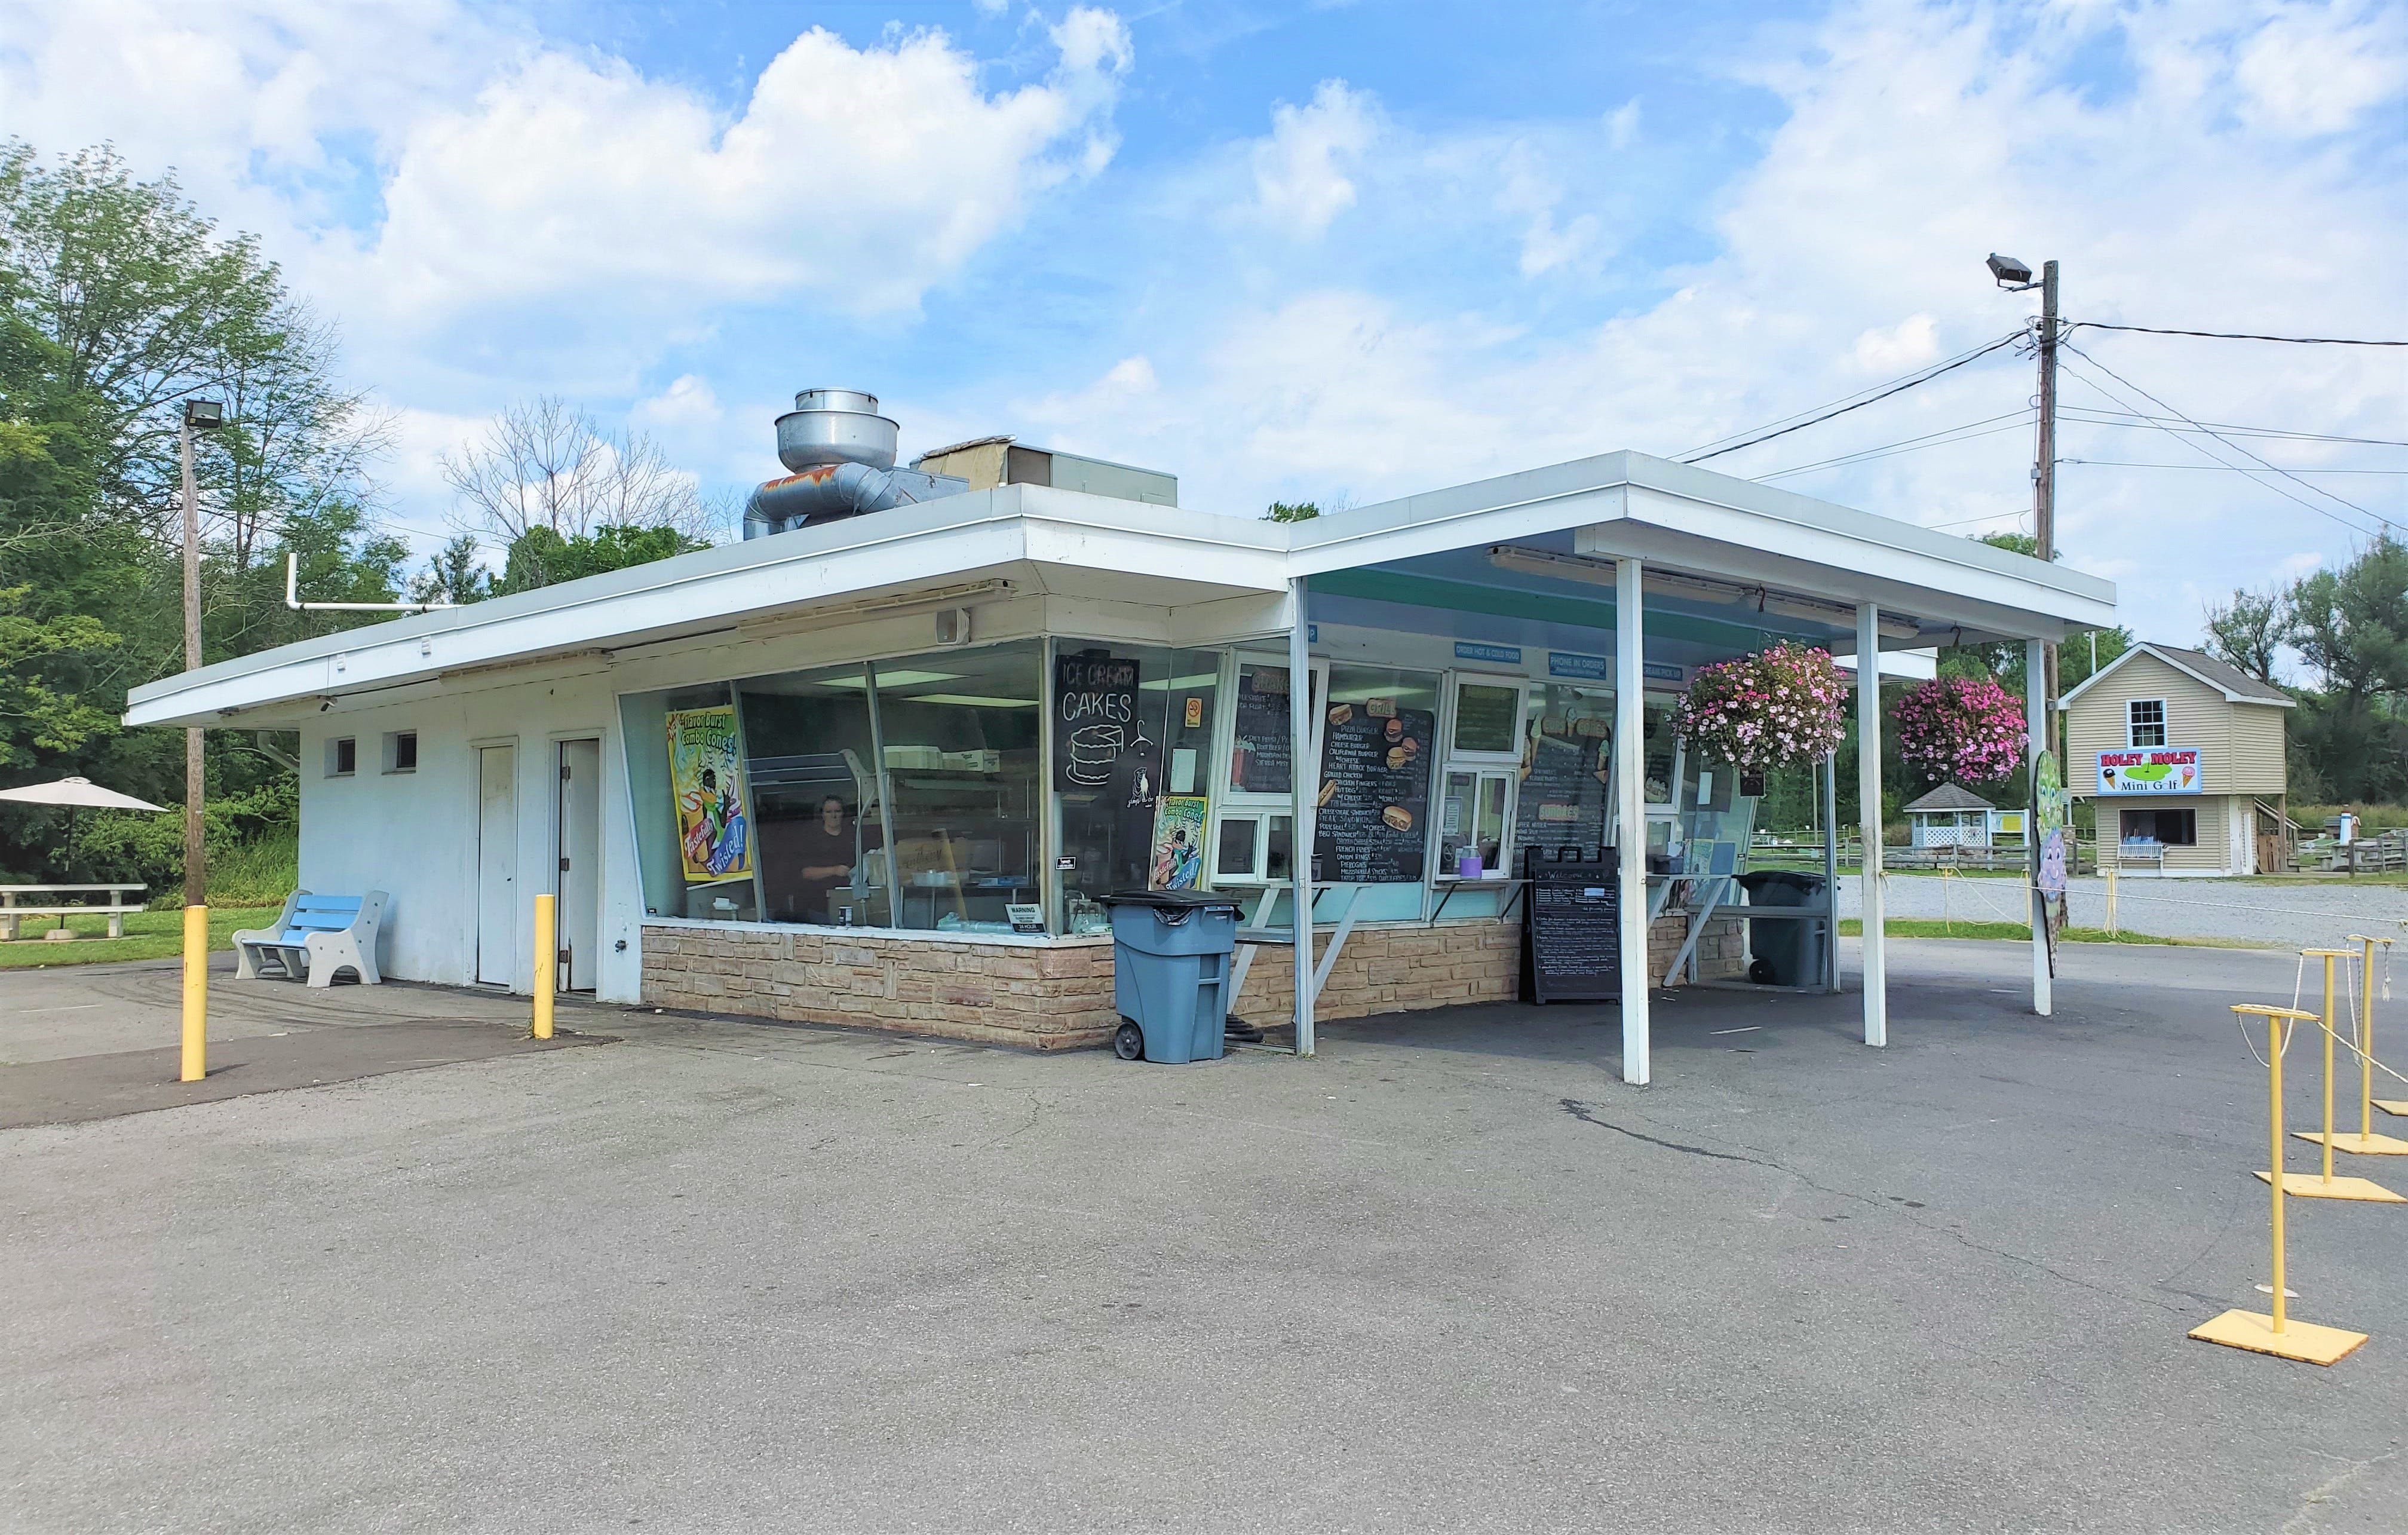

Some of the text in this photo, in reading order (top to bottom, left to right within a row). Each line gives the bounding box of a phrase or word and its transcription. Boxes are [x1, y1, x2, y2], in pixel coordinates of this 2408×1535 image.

[1456, 646, 1473, 654] ORDER
[1550, 657, 1605, 669] PHONE IN ORDERS
[1063, 663, 1134, 687] ICE CREAM
[1063, 692, 1131, 722] CAKES
[1369, 701, 1396, 715] GRILL
[684, 712, 726, 729] Flavor Burst
[682, 729, 737, 756] Combo Cones!
[1332, 731, 1363, 741] HAMBURGER
[1329, 748, 1357, 756] CALIFORNIA
[2101, 751, 2197, 767] HOLEY MOLEY
[1328, 762, 1346, 770] HEART
[1366, 765, 1388, 773] BURGER
[2121, 781, 2148, 791] Mini
[1168, 798, 1200, 808] Flavor Burst
[1164, 807, 1182, 816] Combo
[1539, 807, 1578, 818] SUNDAES
[683, 821, 714, 858] Tastefully
[706, 825, 744, 875] Twisted!
[1152, 858, 1177, 880] Tastefully
[1340, 860, 1367, 869] PIEROGIES
[1165, 862, 1201, 890] Twisted!
